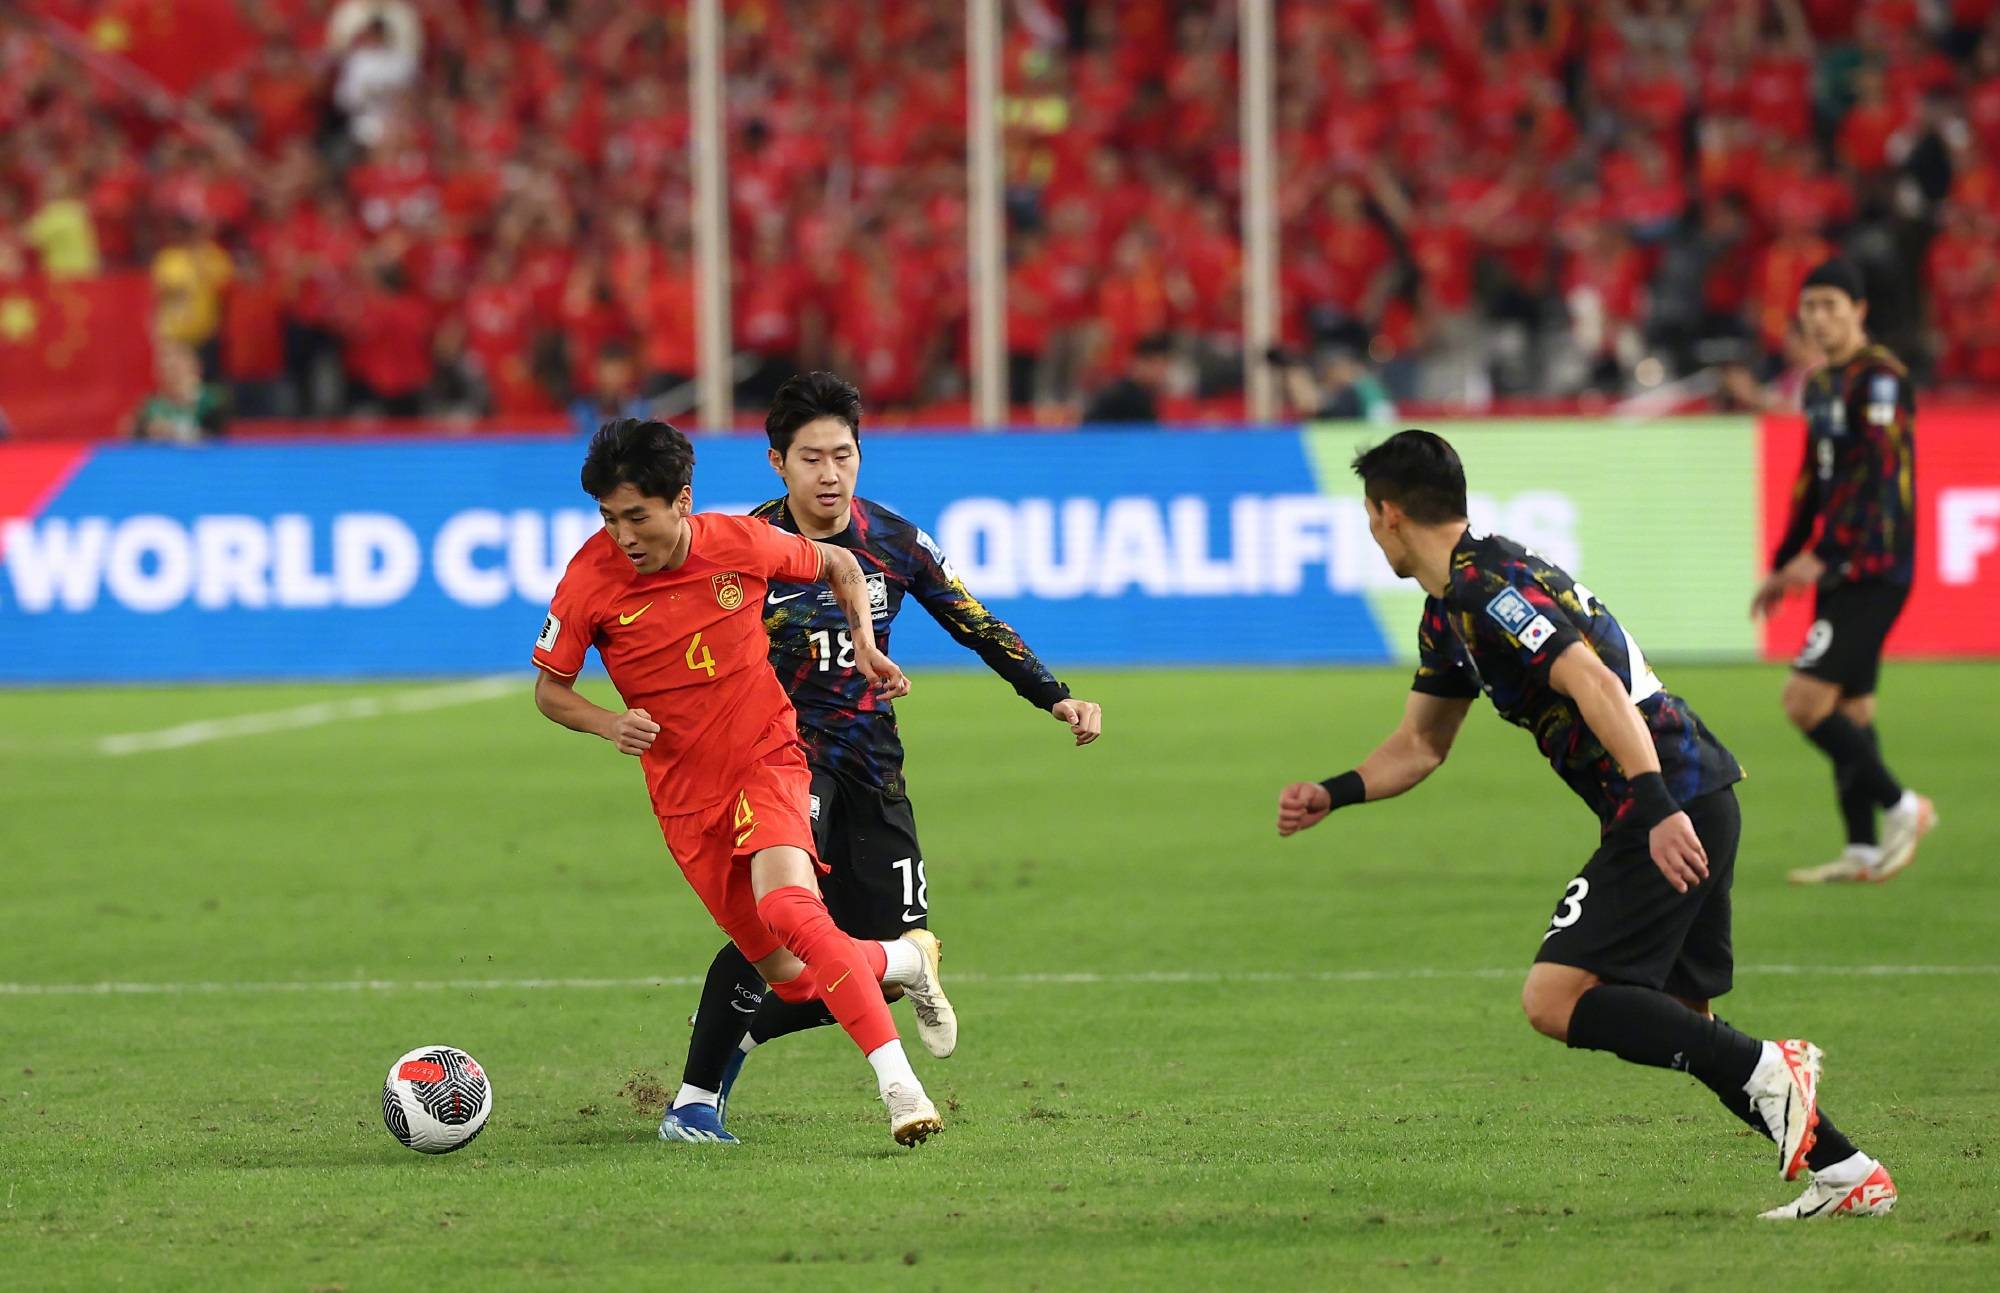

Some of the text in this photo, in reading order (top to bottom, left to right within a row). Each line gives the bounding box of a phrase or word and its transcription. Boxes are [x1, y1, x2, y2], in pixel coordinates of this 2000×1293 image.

[2, 515, 422, 611] WORLD
[433, 508, 604, 608] CU
[686, 631, 716, 677] 4
[809, 629, 857, 672] 18
[735, 789, 754, 829] 4
